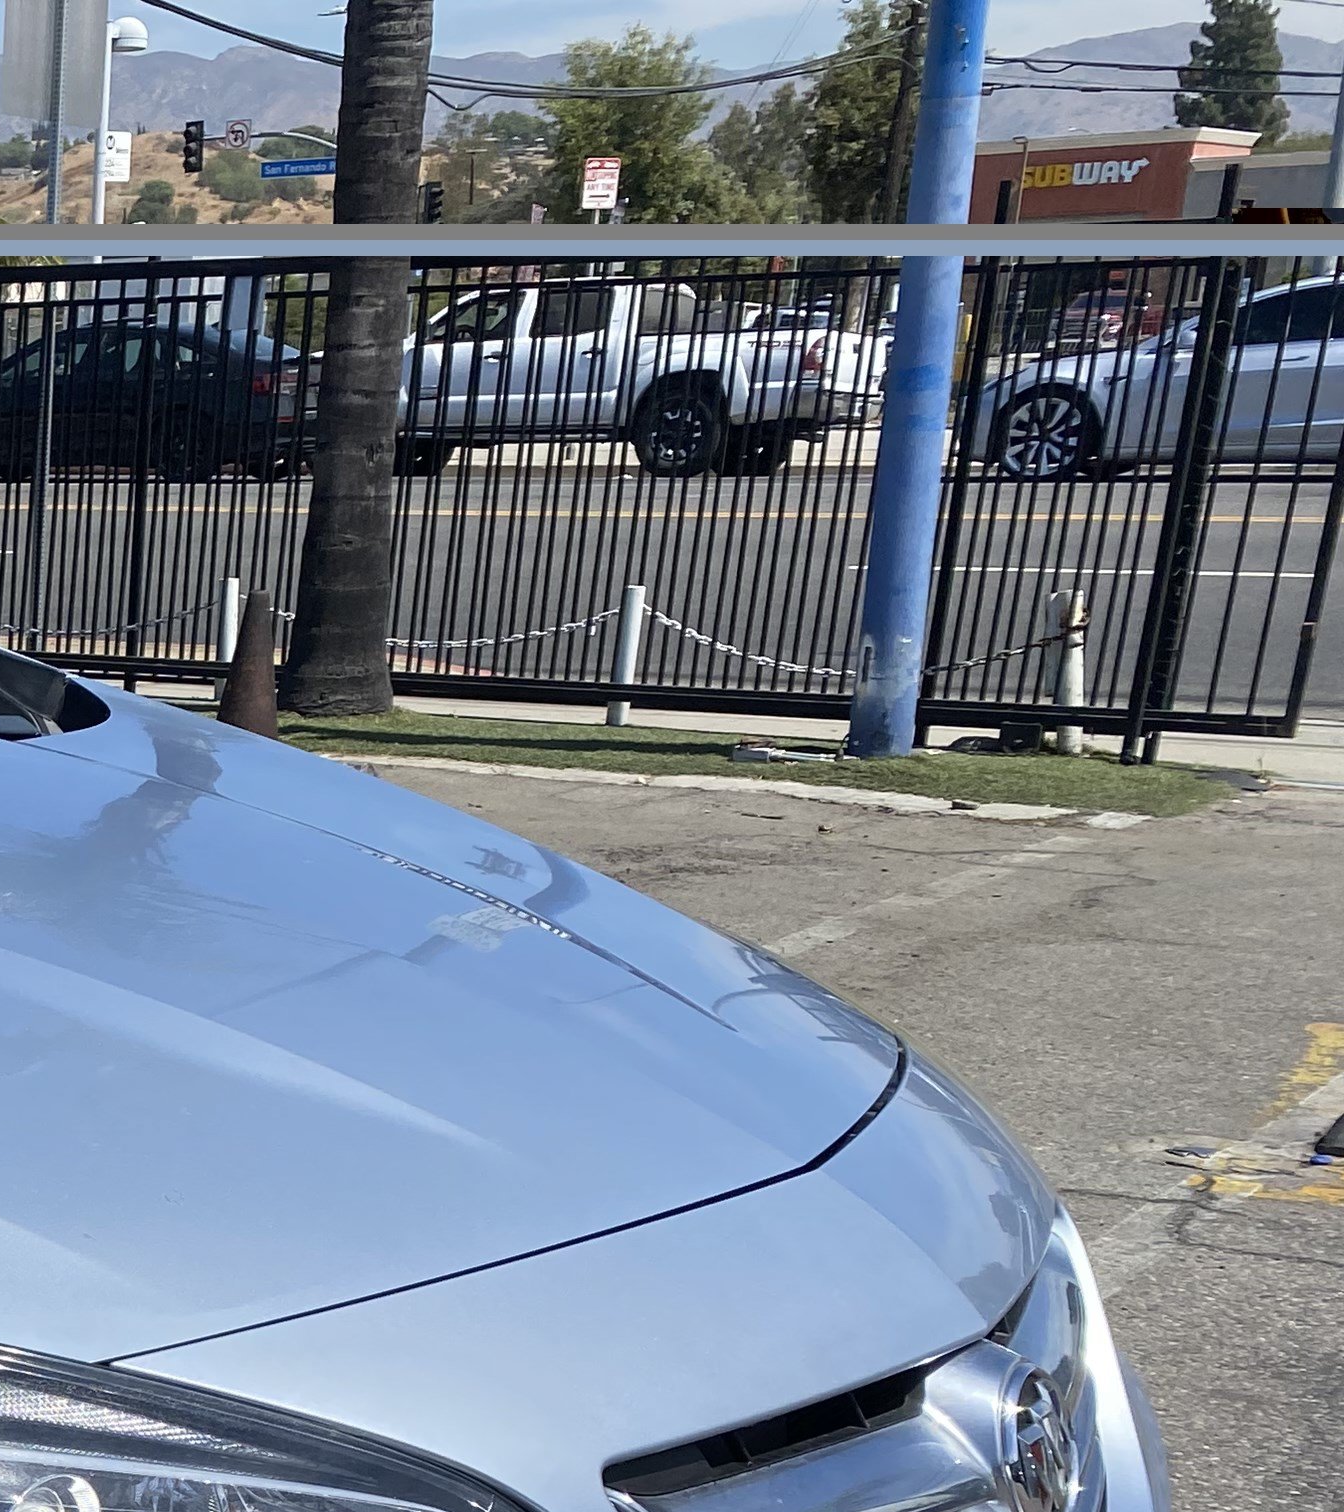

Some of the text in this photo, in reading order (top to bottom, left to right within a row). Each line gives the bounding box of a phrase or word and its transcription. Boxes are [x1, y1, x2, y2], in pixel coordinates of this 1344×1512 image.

[264, 164, 282, 175] San
[284, 163, 327, 174] Fernando
[1023, 157, 1150, 189] SUBWAY
